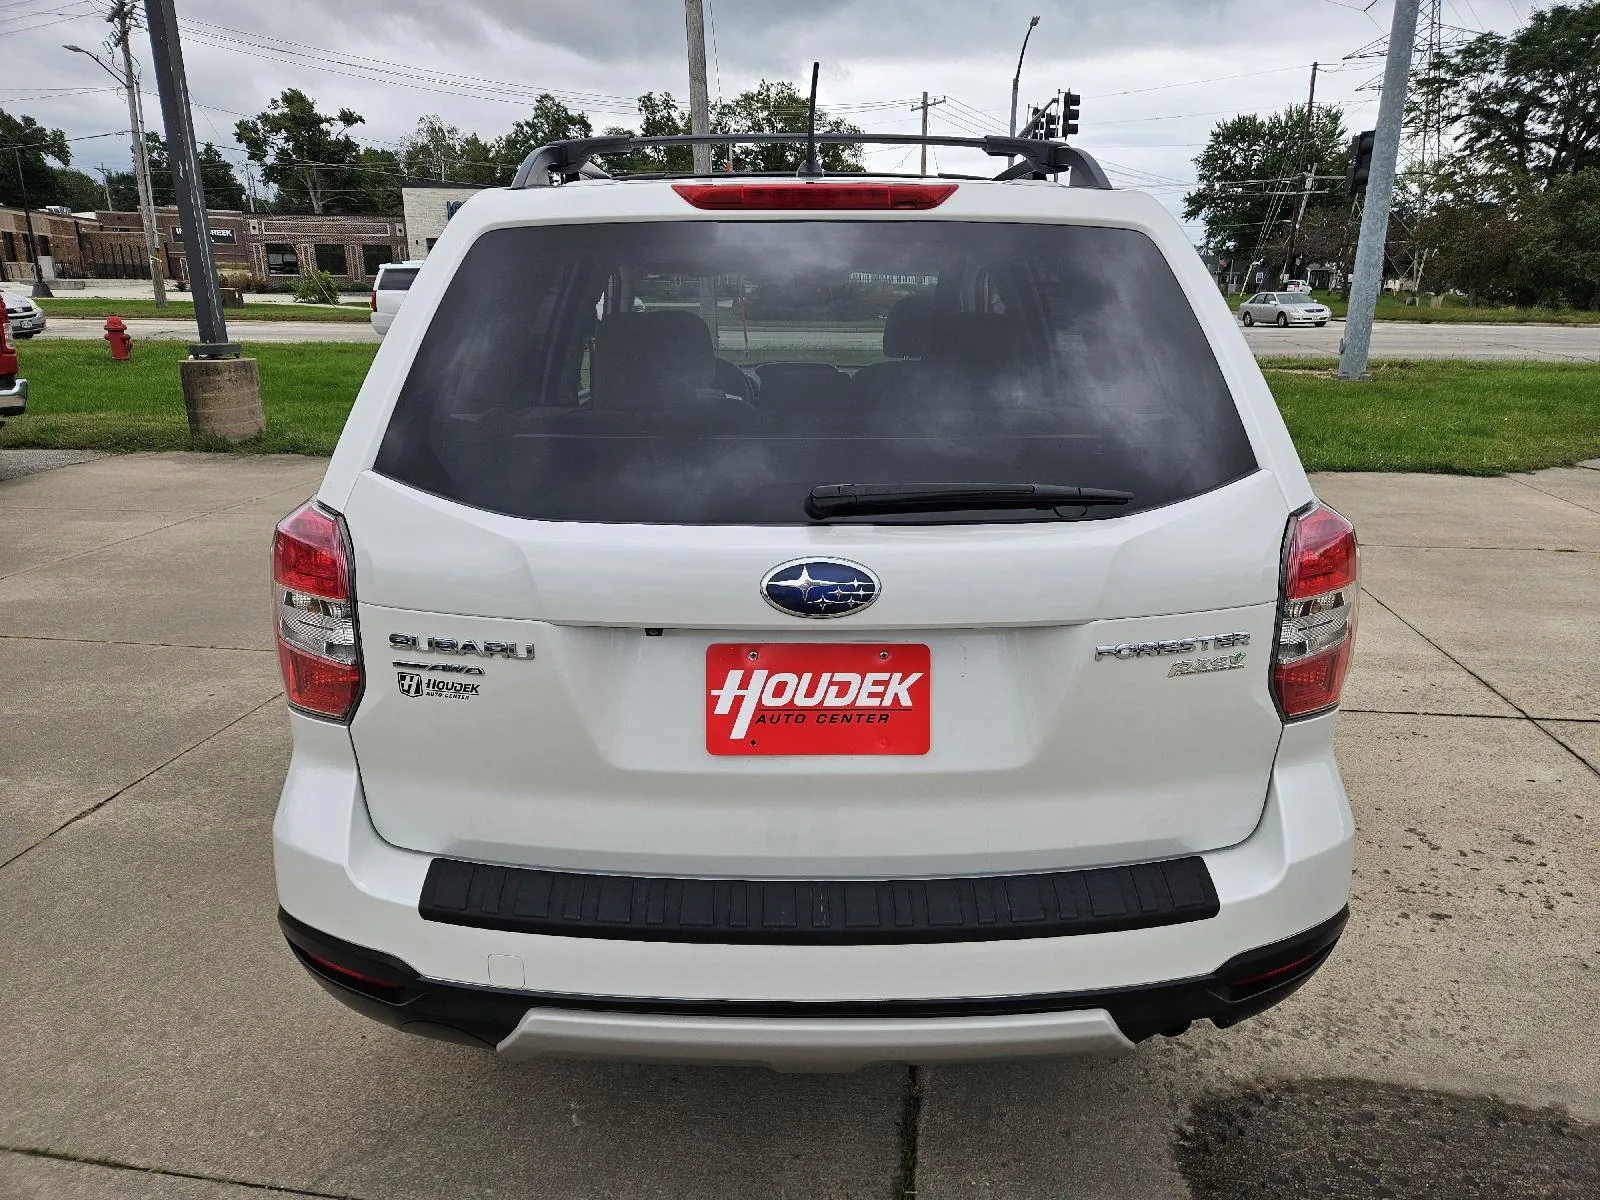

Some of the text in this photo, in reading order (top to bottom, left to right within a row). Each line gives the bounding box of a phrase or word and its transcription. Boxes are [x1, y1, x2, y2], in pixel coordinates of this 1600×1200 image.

[388, 633, 535, 660] SUBARU
[1095, 631, 1251, 661] FORESTER
[425, 679, 480, 693] HOUDEK
[711, 669, 924, 740] HOUDEK
[755, 713, 889, 724] AUTO CENTER
